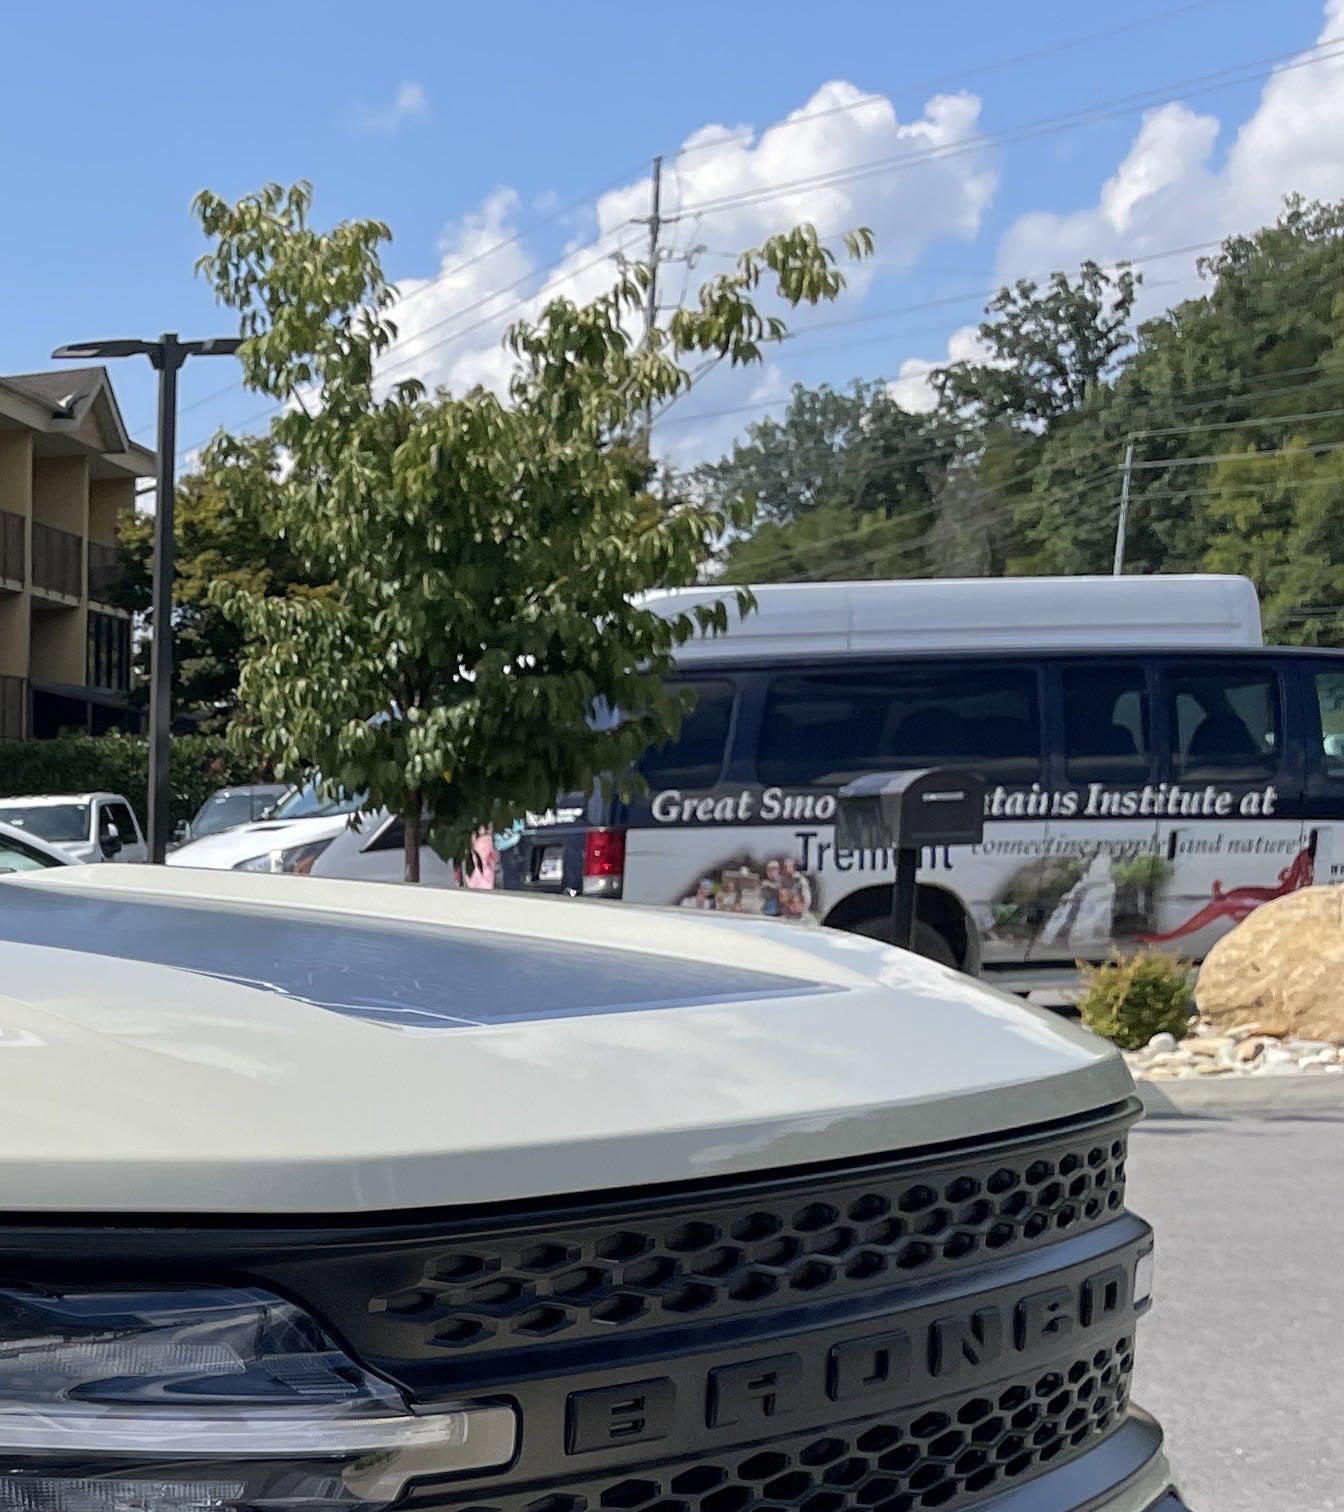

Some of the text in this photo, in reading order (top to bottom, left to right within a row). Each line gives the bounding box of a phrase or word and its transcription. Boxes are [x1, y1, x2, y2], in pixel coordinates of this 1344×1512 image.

[651, 789, 753, 823] Great
[760, 786, 837, 821] Smo
[1084, 782, 1233, 816] Institute
[1240, 785, 1279, 816] at
[565, 1263, 1131, 1456] BRONCO
